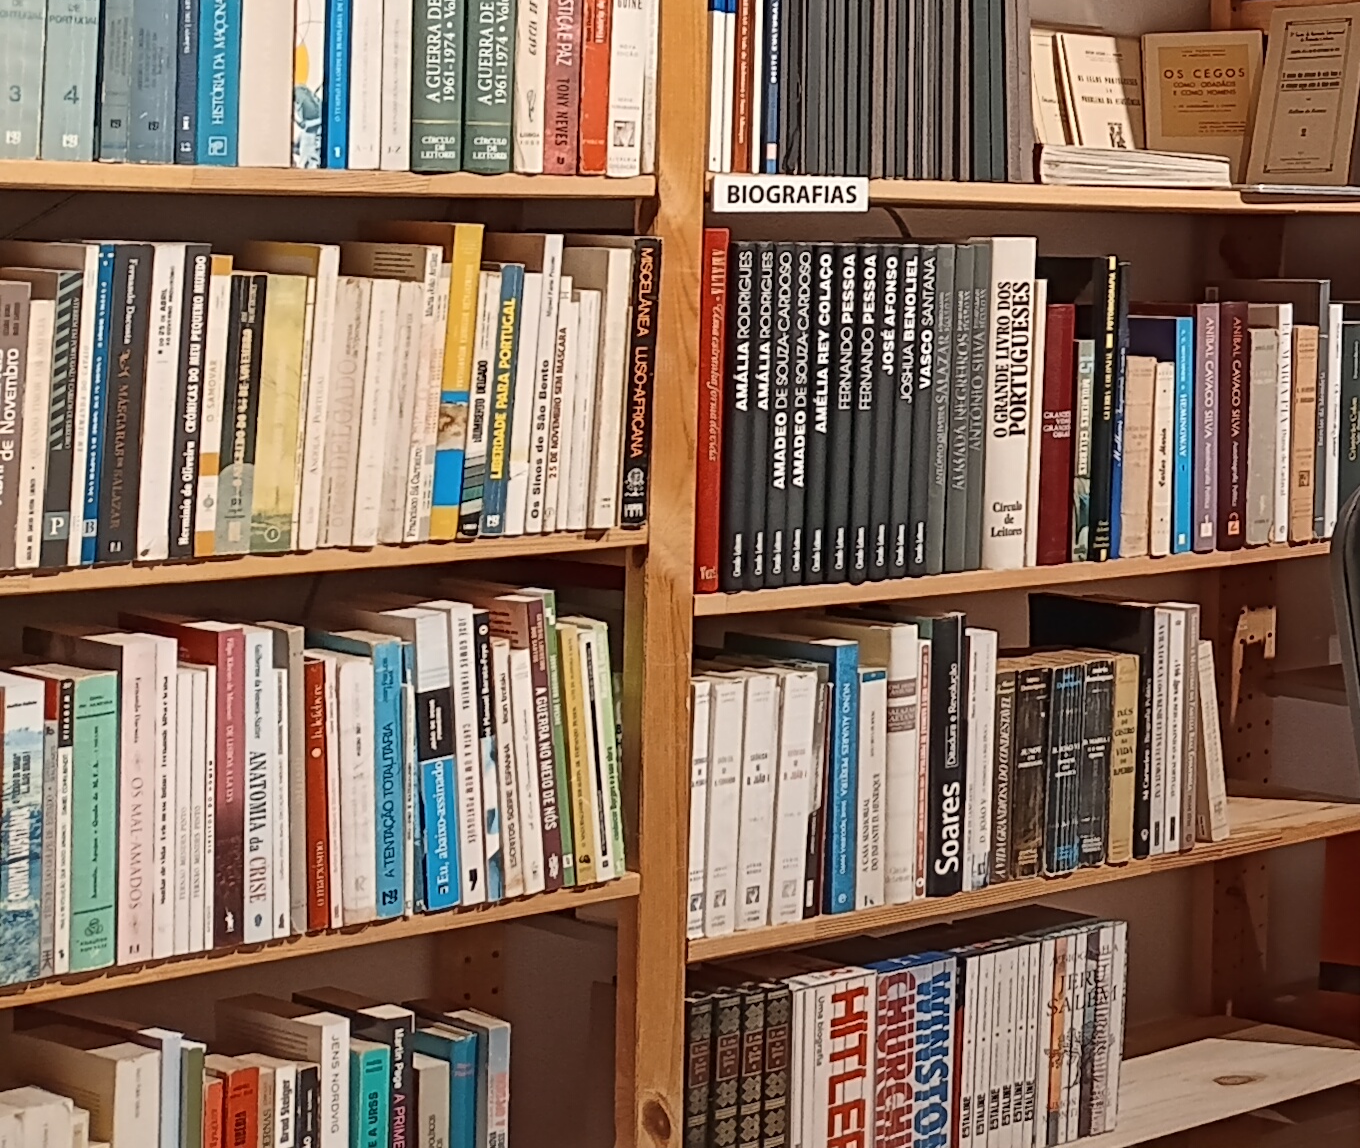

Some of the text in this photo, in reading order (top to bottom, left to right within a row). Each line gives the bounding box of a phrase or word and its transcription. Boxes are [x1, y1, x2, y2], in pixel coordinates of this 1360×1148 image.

[425, 23, 441, 89] GUERRA
[477, 28, 494, 92] GUERRA
[479, 1, 493, 22] DE
[556, 38, 572, 66] PAZ
[63, 84, 79, 104] 4
[212, 68, 226, 125] HISTÓRIA
[425, 91, 440, 105] A
[443, 31, 455, 102] 1961-1974
[477, 95, 492, 106] A
[495, 35, 508, 105] 1961-1974
[555, 78, 570, 147] TONY NEVES
[1164, 67, 1246, 80] OS CEGOS
[726, 183, 858, 206] BIOGRAFIAS
[733, 251, 753, 412] AMÁLIA RODRIGUES
[755, 251, 774, 411] AMÁLIA RODRIGUES
[812, 253, 833, 433] AMÉLIA REY COLAÇO
[838, 253, 856, 410] FERNANDO PESSOA
[859, 253, 877, 410] FERNANDO PESSOA
[881, 256, 898, 376] JOSÉ AFONSO
[900, 255, 919, 404] JOSHUA BENOLIEL
[918, 256, 936, 390] VASCO SANTANA
[993, 280, 1012, 438] O GRANDE LIVRO DOS
[1008, 280, 1031, 438] PORTUGUESES
[1, 348, 19, 461] de Novembro
[474, 360, 488, 443] HUMBERTO DELGADO
[491, 297, 517, 480] LIBERDADE PARA PORTUGAL
[629, 346, 650, 459] LUSO-AFRICANA
[772, 251, 793, 490] AMADEO DE SOUZA-CARDOSO
[792, 251, 813, 489] AMADEO DE SOUZA-CARDOSO
[1204, 317, 1215, 440] ANÍBAL CAVACO SILVA
[531, 359, 550, 519] Os Sinos de São Bento
[536, 698, 549, 741] GUERRA
[434, 760, 449, 882] Eu, abaixo-assinado
[541, 760, 553, 788] MEIO
[543, 807, 557, 831] NÓS
[249, 751, 268, 904] ANATOMIA da CRISE
[383, 802, 395, 864] TENTAÇÃO
[385, 867, 395, 879] A
[934, 781, 961, 876] Soares
[330, 1035, 341, 1135] JENS NORDVIG
